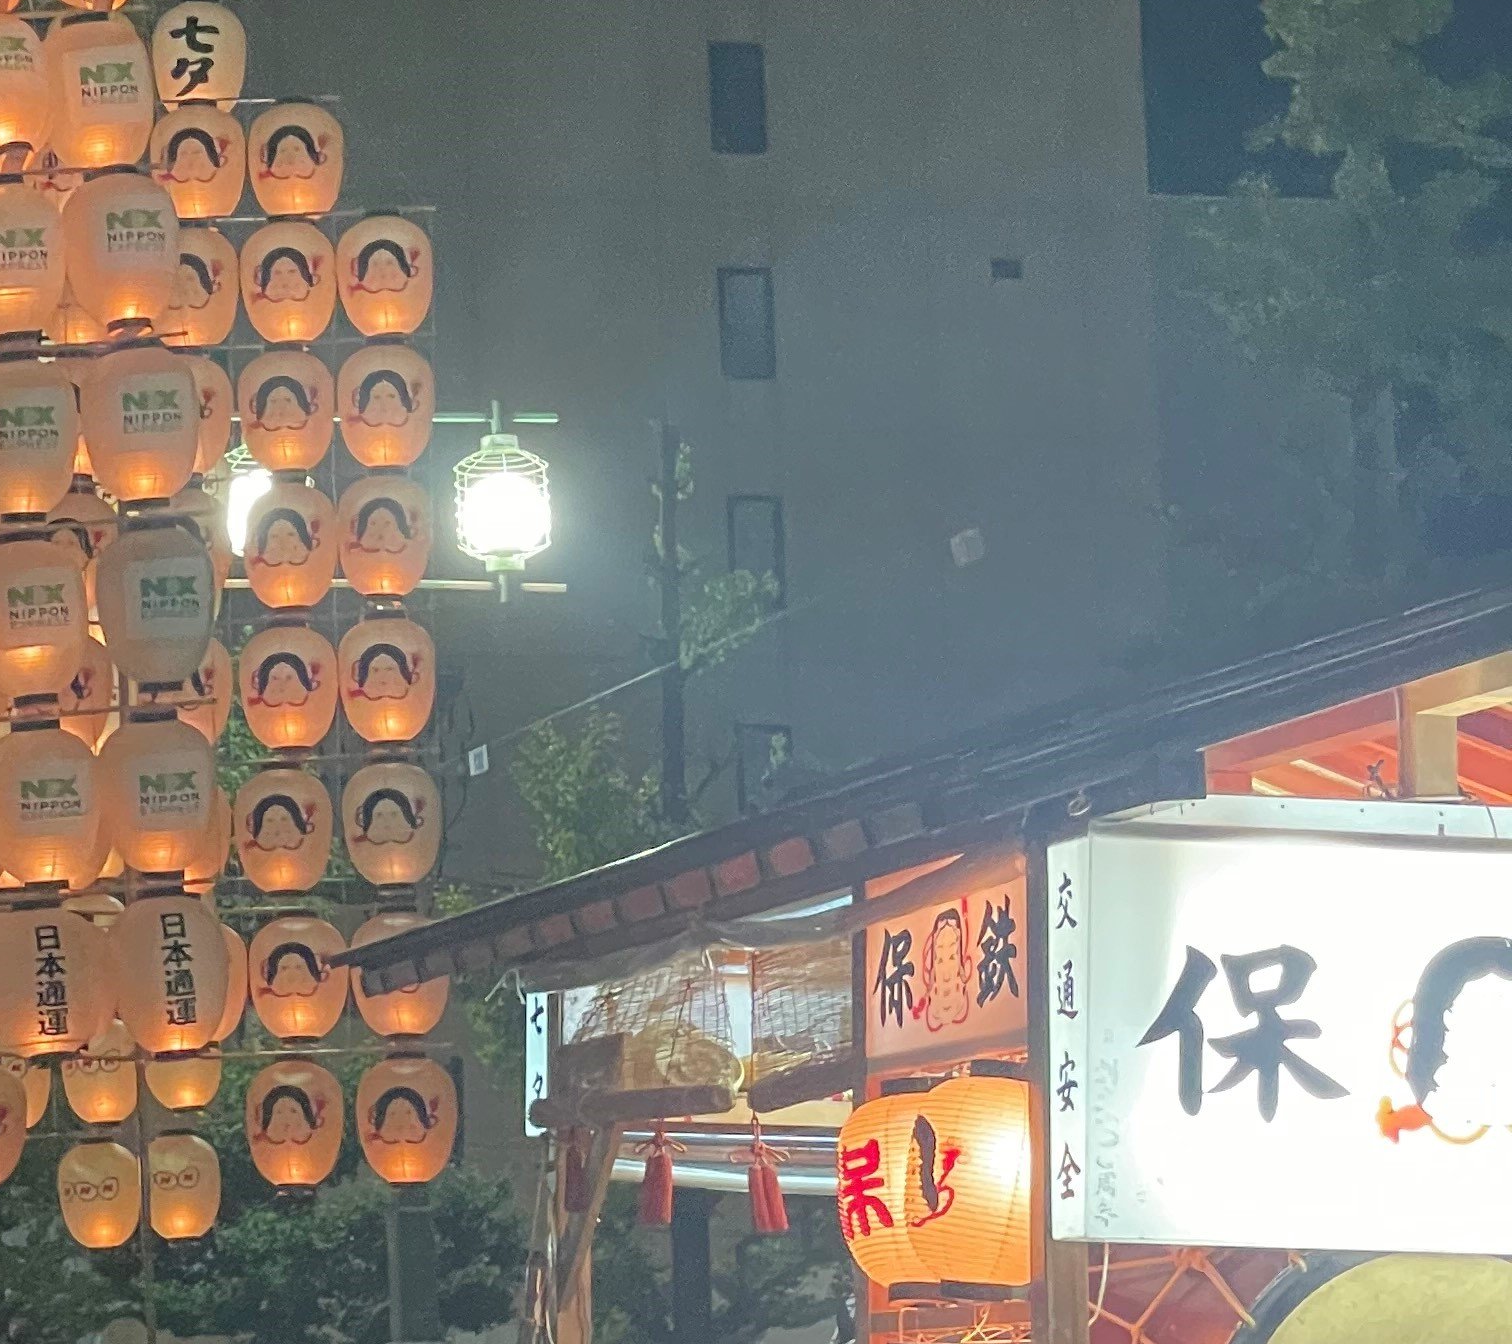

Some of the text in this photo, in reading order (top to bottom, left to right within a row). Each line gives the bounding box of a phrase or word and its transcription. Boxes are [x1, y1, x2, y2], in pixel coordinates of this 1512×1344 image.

[171, 16, 219, 97] 七夕
[80, 62, 134, 83] NX
[81, 84, 138, 97] NIPPON
[106, 210, 163, 230] NX
[107, 232, 165, 243] NIPPON
[123, 390, 180, 410] NX
[124, 411, 181, 422] NIPPON
[0, 428, 58, 440] NIPPON
[8, 584, 65, 606] NX
[140, 576, 197, 597] NX
[9, 606, 68, 619] NIPPON
[21, 777, 80, 798] NX
[140, 772, 196, 793] NX
[22, 800, 81, 810] NIPPON
[140, 793, 200, 804] NIPPON
[160, 912, 197, 1025] 日本通運
[874, 928, 915, 1029] 保
[34, 925, 68, 1035] 日本通運
[1055, 872, 1081, 1200] 交通安全
[1135, 944, 1351, 1124] 保
